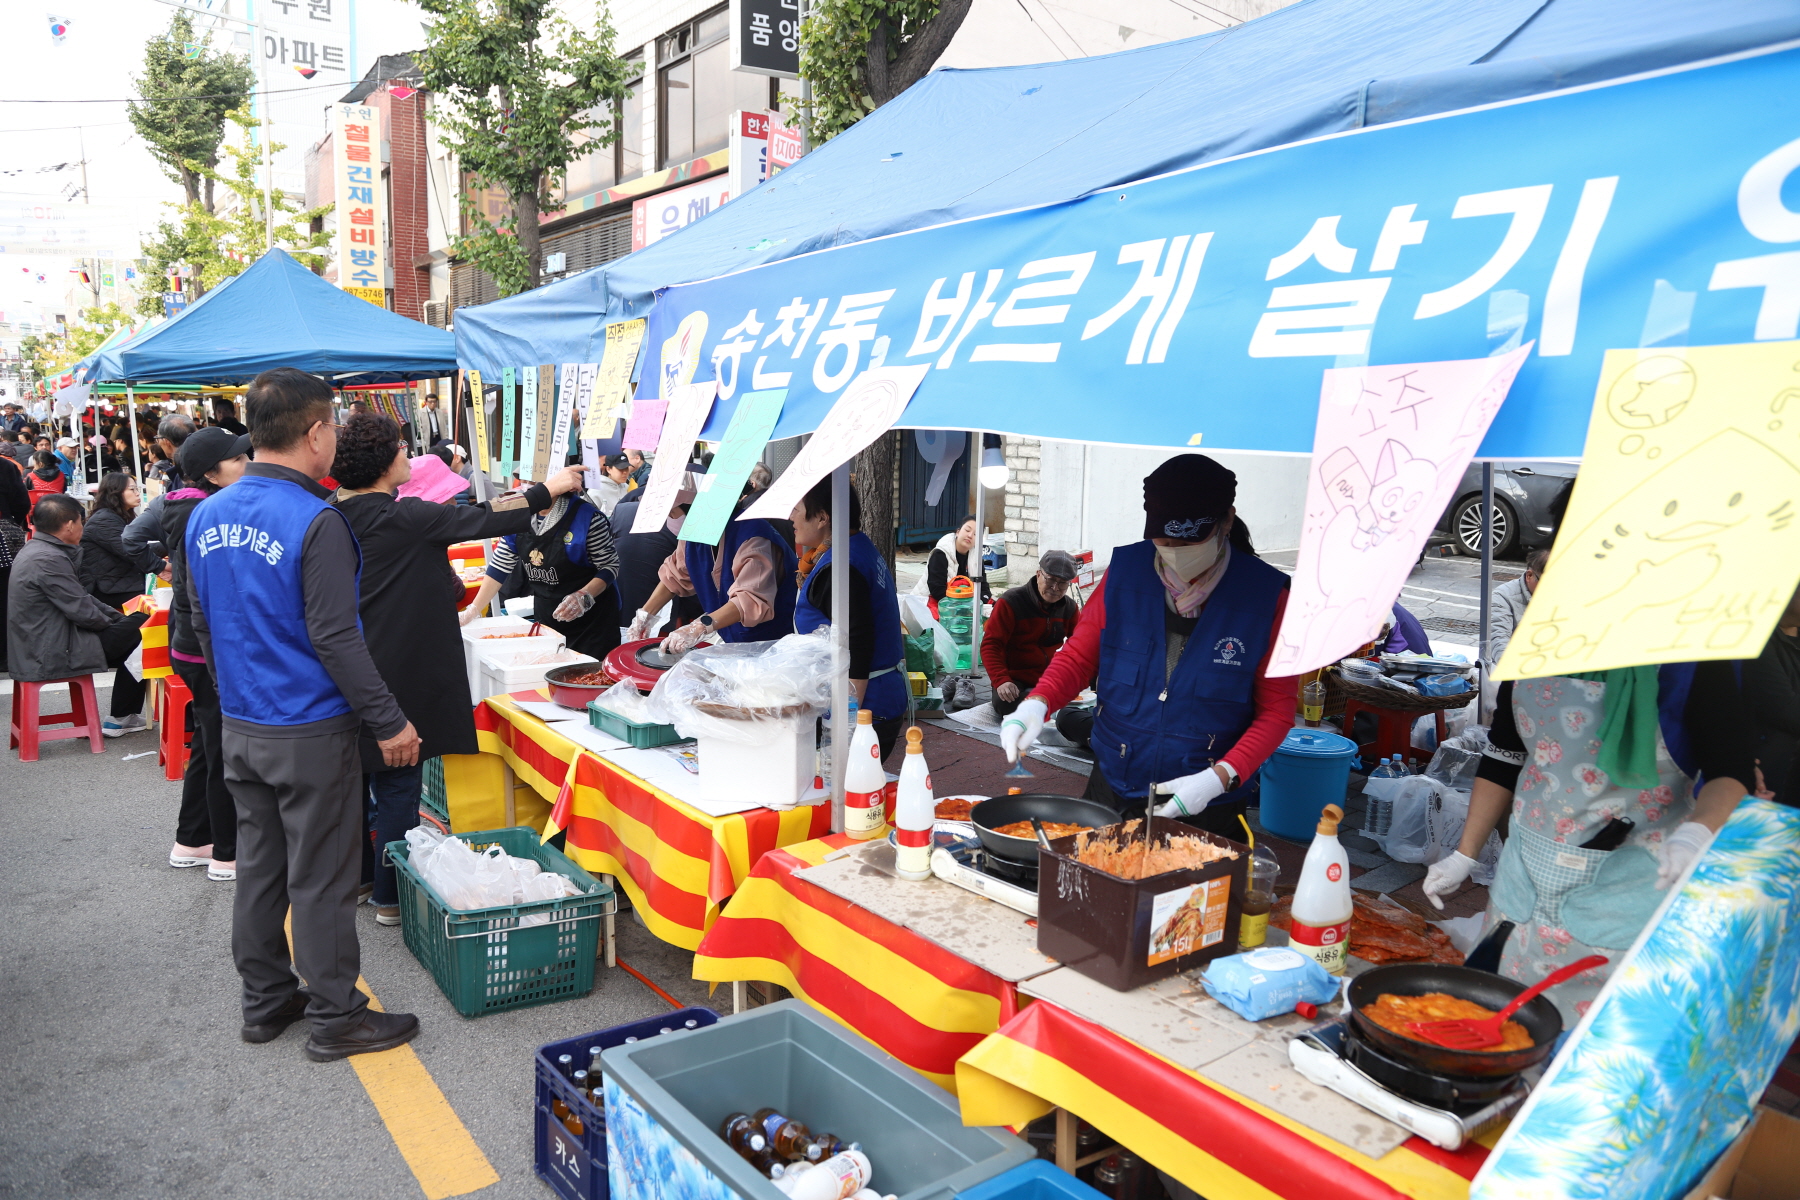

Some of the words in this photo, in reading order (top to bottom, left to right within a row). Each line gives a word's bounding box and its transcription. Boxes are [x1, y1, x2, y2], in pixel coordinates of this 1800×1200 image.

[264, 35, 346, 72] 아파트
[340, 105, 373, 121] 우연
[344, 123, 372, 163] 철물
[347, 165, 374, 204] 건재
[349, 207, 375, 246] 설비
[636, 205, 645, 246] 한식
[350, 249, 379, 287] 방수
[710, 288, 897, 401] 송천동
[906, 231, 1214, 370] 바르게
[1248, 176, 1620, 358] 살기
[607, 322, 625, 343] 직접
[525, 367, 534, 402] 소주
[1350, 369, 1434, 438] 소주
[504, 369, 513, 449] 홍어보쌈
[524, 407, 534, 448] 맥주
[537, 388, 551, 455] 막걸리
[553, 365, 575, 456] 생막걸리
[196, 523, 285, 566] 바르게살기운동
[1519, 605, 1612, 676] 홍어
[1647, 586, 1782, 654] 보쌈
[1488, 744, 1529, 762] SPORT
[1314, 949, 1339, 963] 식용유
[555, 1135, 580, 1179] 카스
